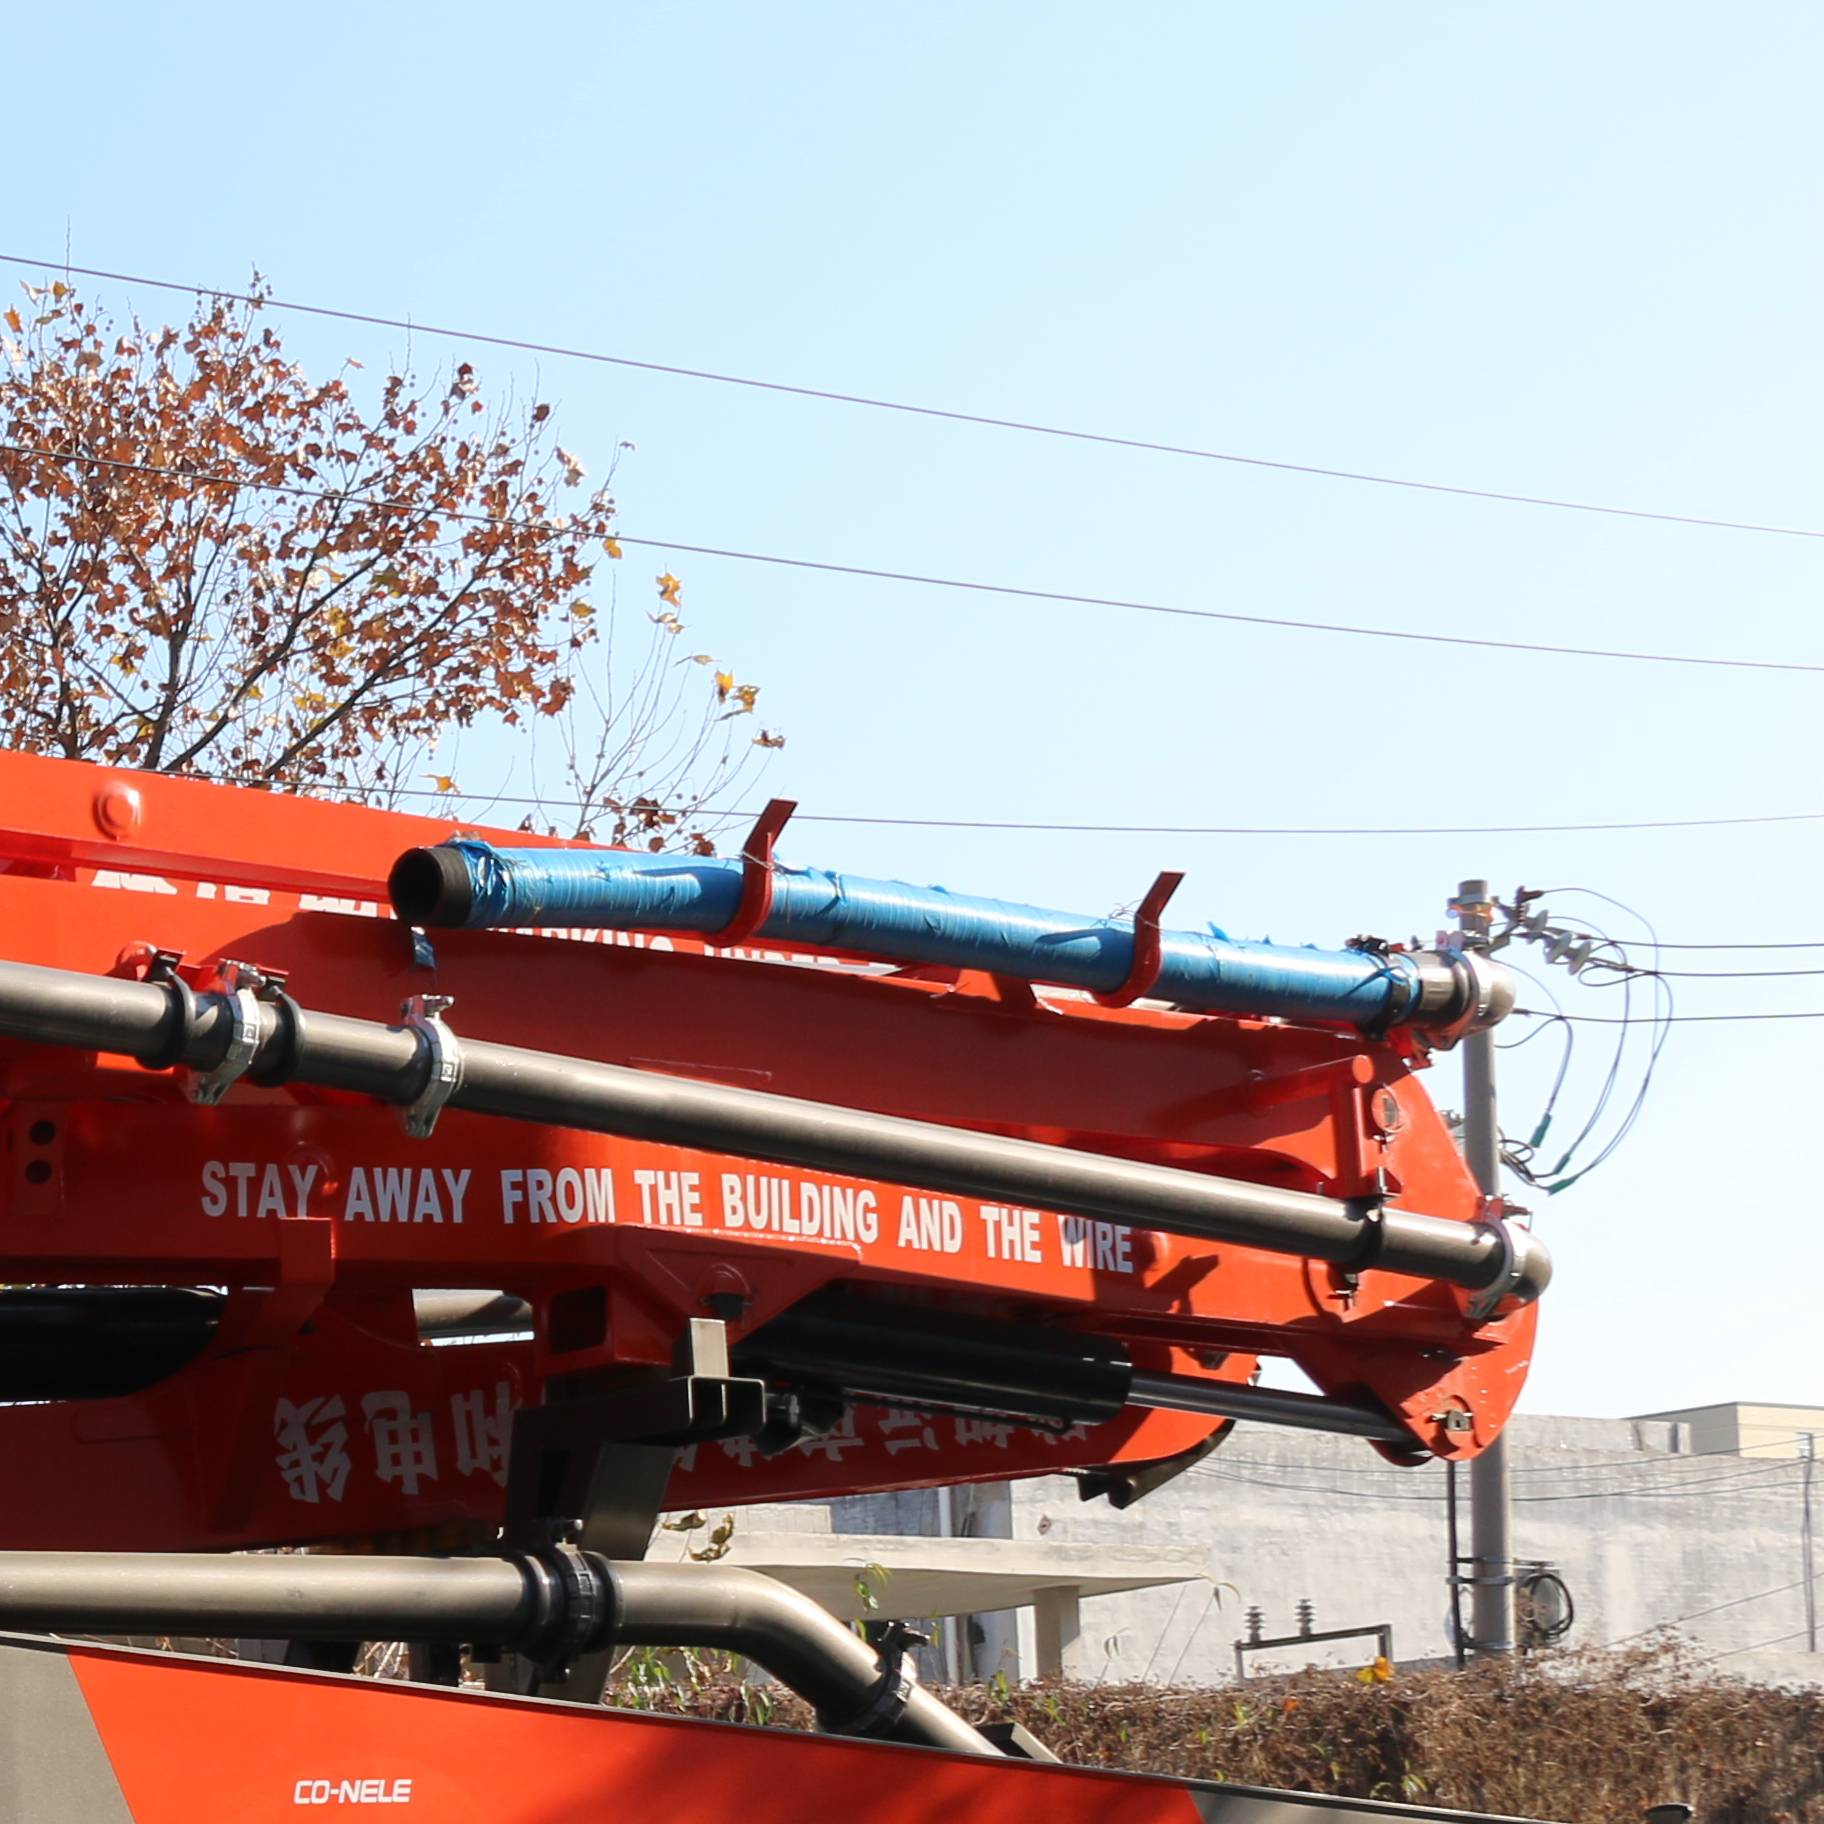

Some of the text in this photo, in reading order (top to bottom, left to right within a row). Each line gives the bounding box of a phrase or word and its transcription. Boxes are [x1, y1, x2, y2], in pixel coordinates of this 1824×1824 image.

[201, 1161, 1135, 1275] STAY AWAY FROM THE BUILDING AND THE WIRE
[293, 1778, 413, 1805] CO-NELE
